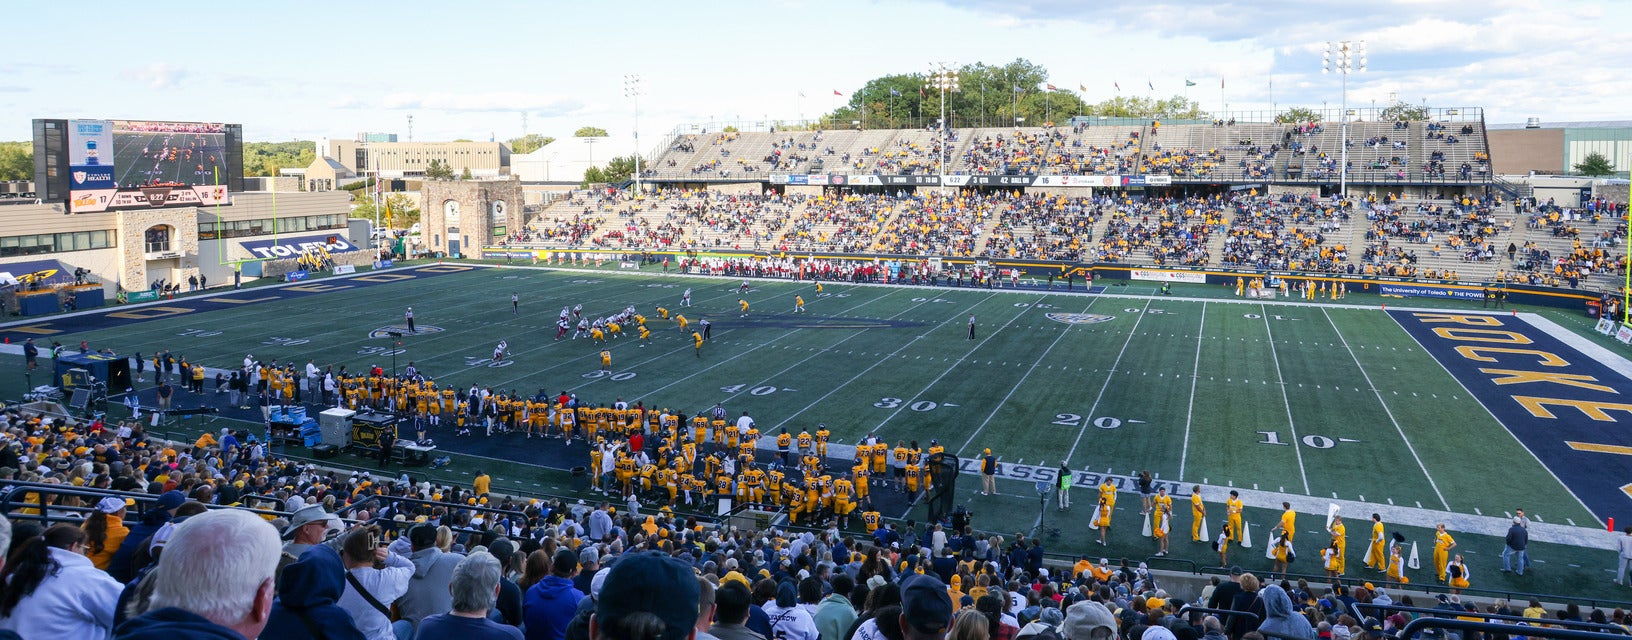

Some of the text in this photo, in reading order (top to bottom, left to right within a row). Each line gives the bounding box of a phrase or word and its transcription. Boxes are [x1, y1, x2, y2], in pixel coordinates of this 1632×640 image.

[252, 240, 349, 258] TOLEDO
[720, 383, 777, 396] 40
[873, 397, 937, 412] 30
[1051, 413, 1122, 429] 20
[1256, 430, 1335, 449] 10
[897, 452, 906, 460] 67
[858, 470, 867, 479] 64
[866, 515, 875, 524] 58
